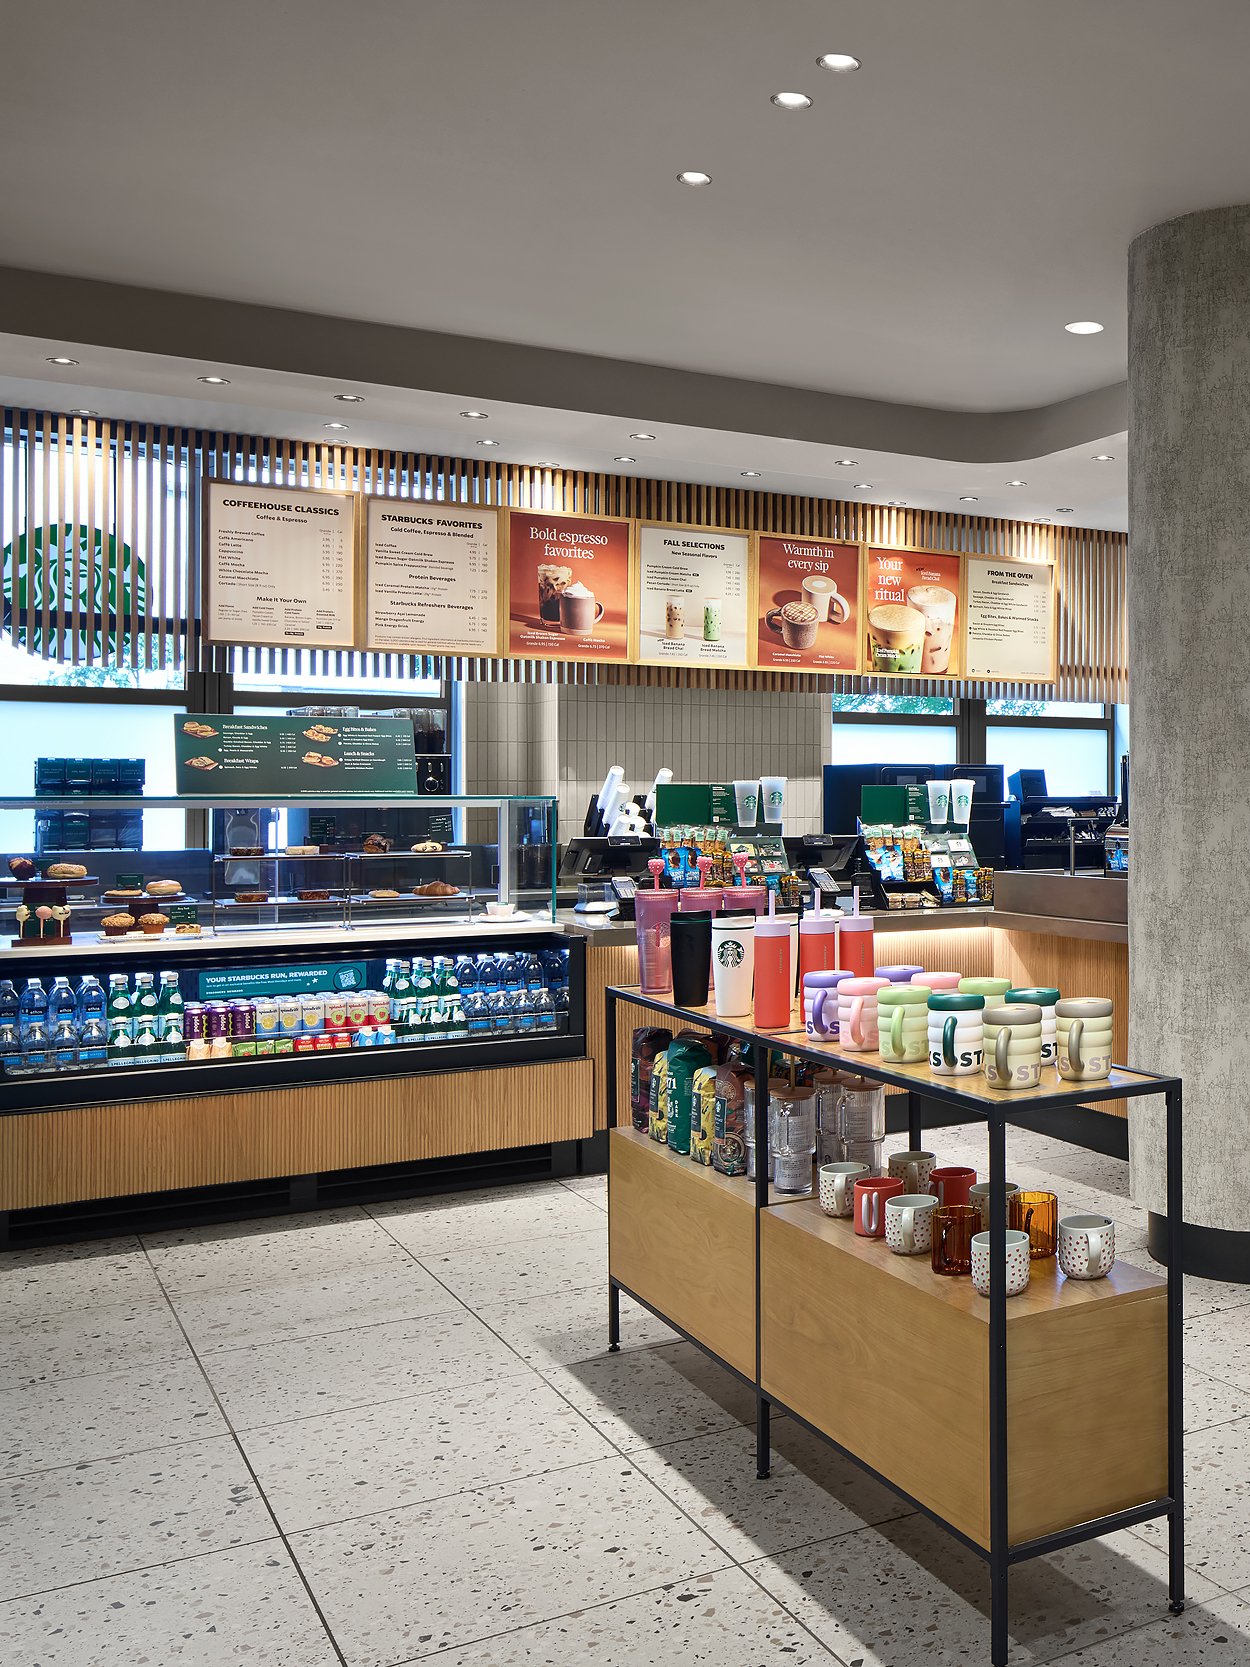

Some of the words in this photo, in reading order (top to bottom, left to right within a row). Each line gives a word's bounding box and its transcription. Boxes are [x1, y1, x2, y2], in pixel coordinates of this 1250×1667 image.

[223, 499, 292, 512] COFFEEHOUSE
[295, 506, 339, 516] CLASSICS
[381, 514, 433, 525] STARBUCKS
[437, 520, 482, 529] FAVORITES
[530, 527, 556, 541] Bold
[560, 532, 608, 546] espresso
[544, 544, 594, 559] favorites
[682, 542, 725, 550] SELECTIONS
[783, 544, 823, 558] Warmth
[825, 548, 834, 558] in
[788, 559, 813, 572] every
[815, 561, 829, 572] sip
[877, 557, 903, 570] Your
[878, 575, 902, 586] new
[874, 588, 905, 602] ritual
